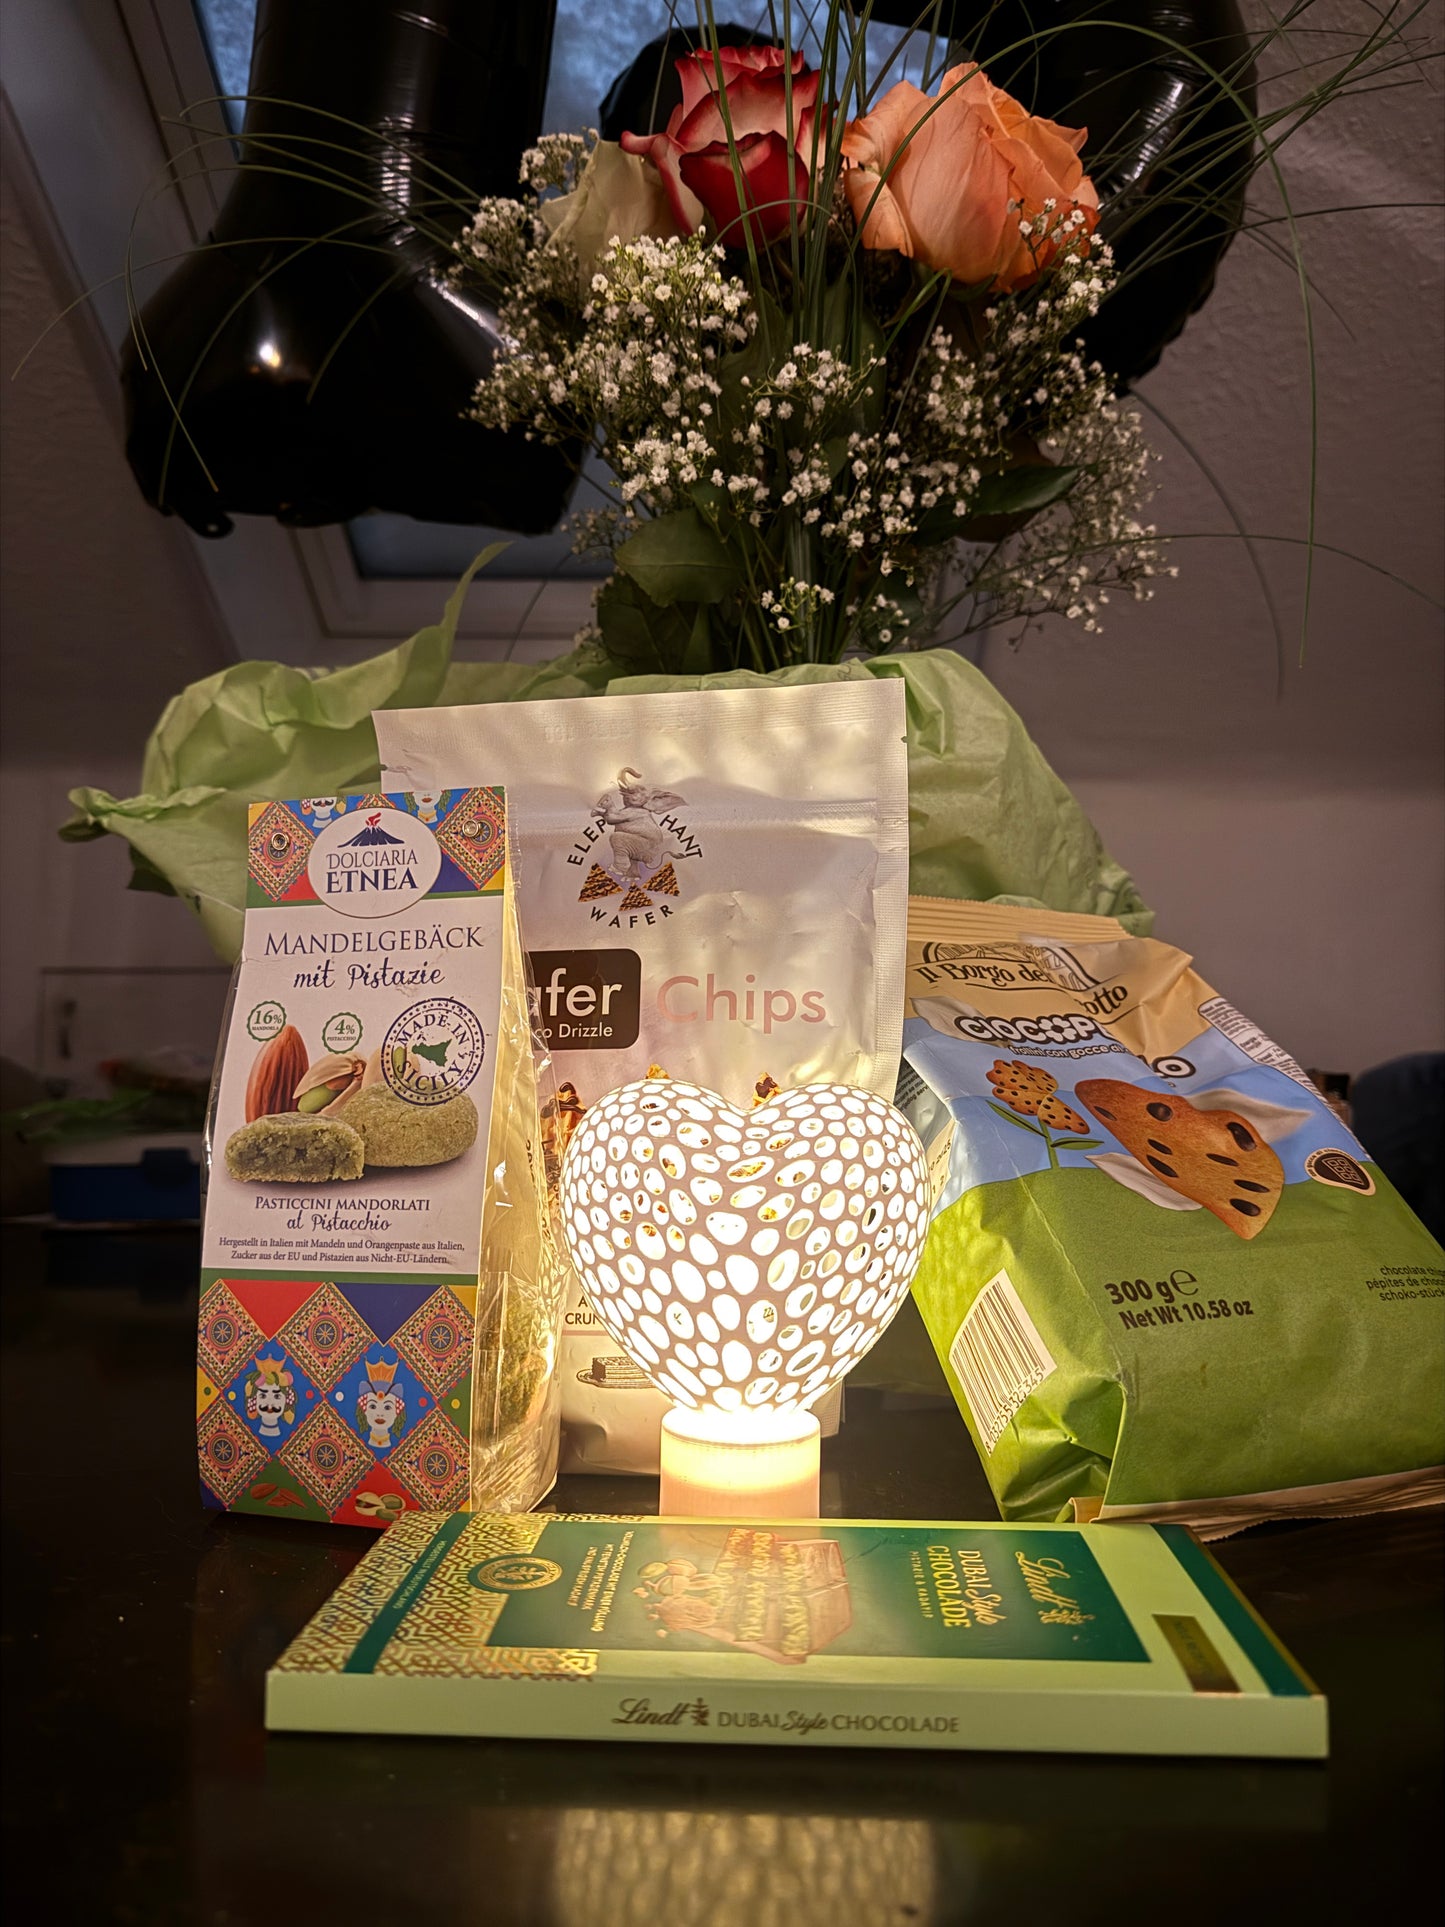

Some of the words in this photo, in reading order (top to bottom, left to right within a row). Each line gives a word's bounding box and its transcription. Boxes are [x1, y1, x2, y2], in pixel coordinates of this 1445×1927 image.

[326, 849, 418, 870] DOLCIARIA
[326, 867, 418, 894] ETNEA
[591, 904, 673, 928] WAFER
[264, 924, 484, 956] MANDELGEBÄCK
[293, 959, 335, 989] mit
[347, 957, 445, 990] Pistazie
[913, 966, 942, 984] Il
[937, 963, 1016, 987] Borgo
[1018, 964, 1050, 983] de
[657, 973, 826, 1034] Chips
[1083, 986, 1128, 1015] otto
[254, 1010, 282, 1025] 16%
[334, 1019, 355, 1035] 4%
[397, 1013, 448, 1046] MADE
[451, 1023, 470, 1045] IN
[559, 1022, 613, 1038] Drizzle
[1046, 1049, 1068, 1057] con
[1068, 1045, 1109, 1060] gocce
[397, 1060, 463, 1090] SICILY
[255, 1196, 331, 1210] PASTICCINI
[335, 1199, 430, 1211] MANDORLATI
[287, 1210, 304, 1229] al
[311, 1210, 392, 1232] Pistacchio
[219, 1237, 259, 1248] Hergestellt
[260, 1238, 268, 1247] in
[270, 1238, 293, 1248] Italien
[295, 1239, 309, 1248] mit
[310, 1239, 345, 1248] Mandeln
[347, 1240, 363, 1249] und
[365, 1240, 420, 1252] Orangenpaste
[437, 1241, 465, 1251] Italien,
[231, 1250, 258, 1260] Zucker
[273, 1251, 286, 1260] der
[288, 1252, 301, 1261] EU
[302, 1252, 318, 1261] und
[320, 1252, 354, 1262] Pistazien
[1366, 1277, 1405, 1291] pépites
[1406, 1276, 1420, 1287] de
[1380, 1265, 1426, 1276] chocolate
[1104, 1279, 1153, 1305] 300
[1118, 1309, 1157, 1330] Net
[1152, 1305, 1183, 1325] Wt
[1182, 1299, 1231, 1321] 10.58
[1233, 1301, 1254, 1316] oz
[957, 1550, 992, 1588] DUBAI
[1015, 1551, 1080, 1609] Lindt
[927, 1545, 972, 1628] CHOCOLADE
[961, 1588, 1007, 1625] Style
[612, 1698, 691, 1726] Lindt
[717, 1711, 780, 1728] DUBAI
[780, 1711, 829, 1736] Style
[831, 1714, 960, 1733] CHOCOLADE
